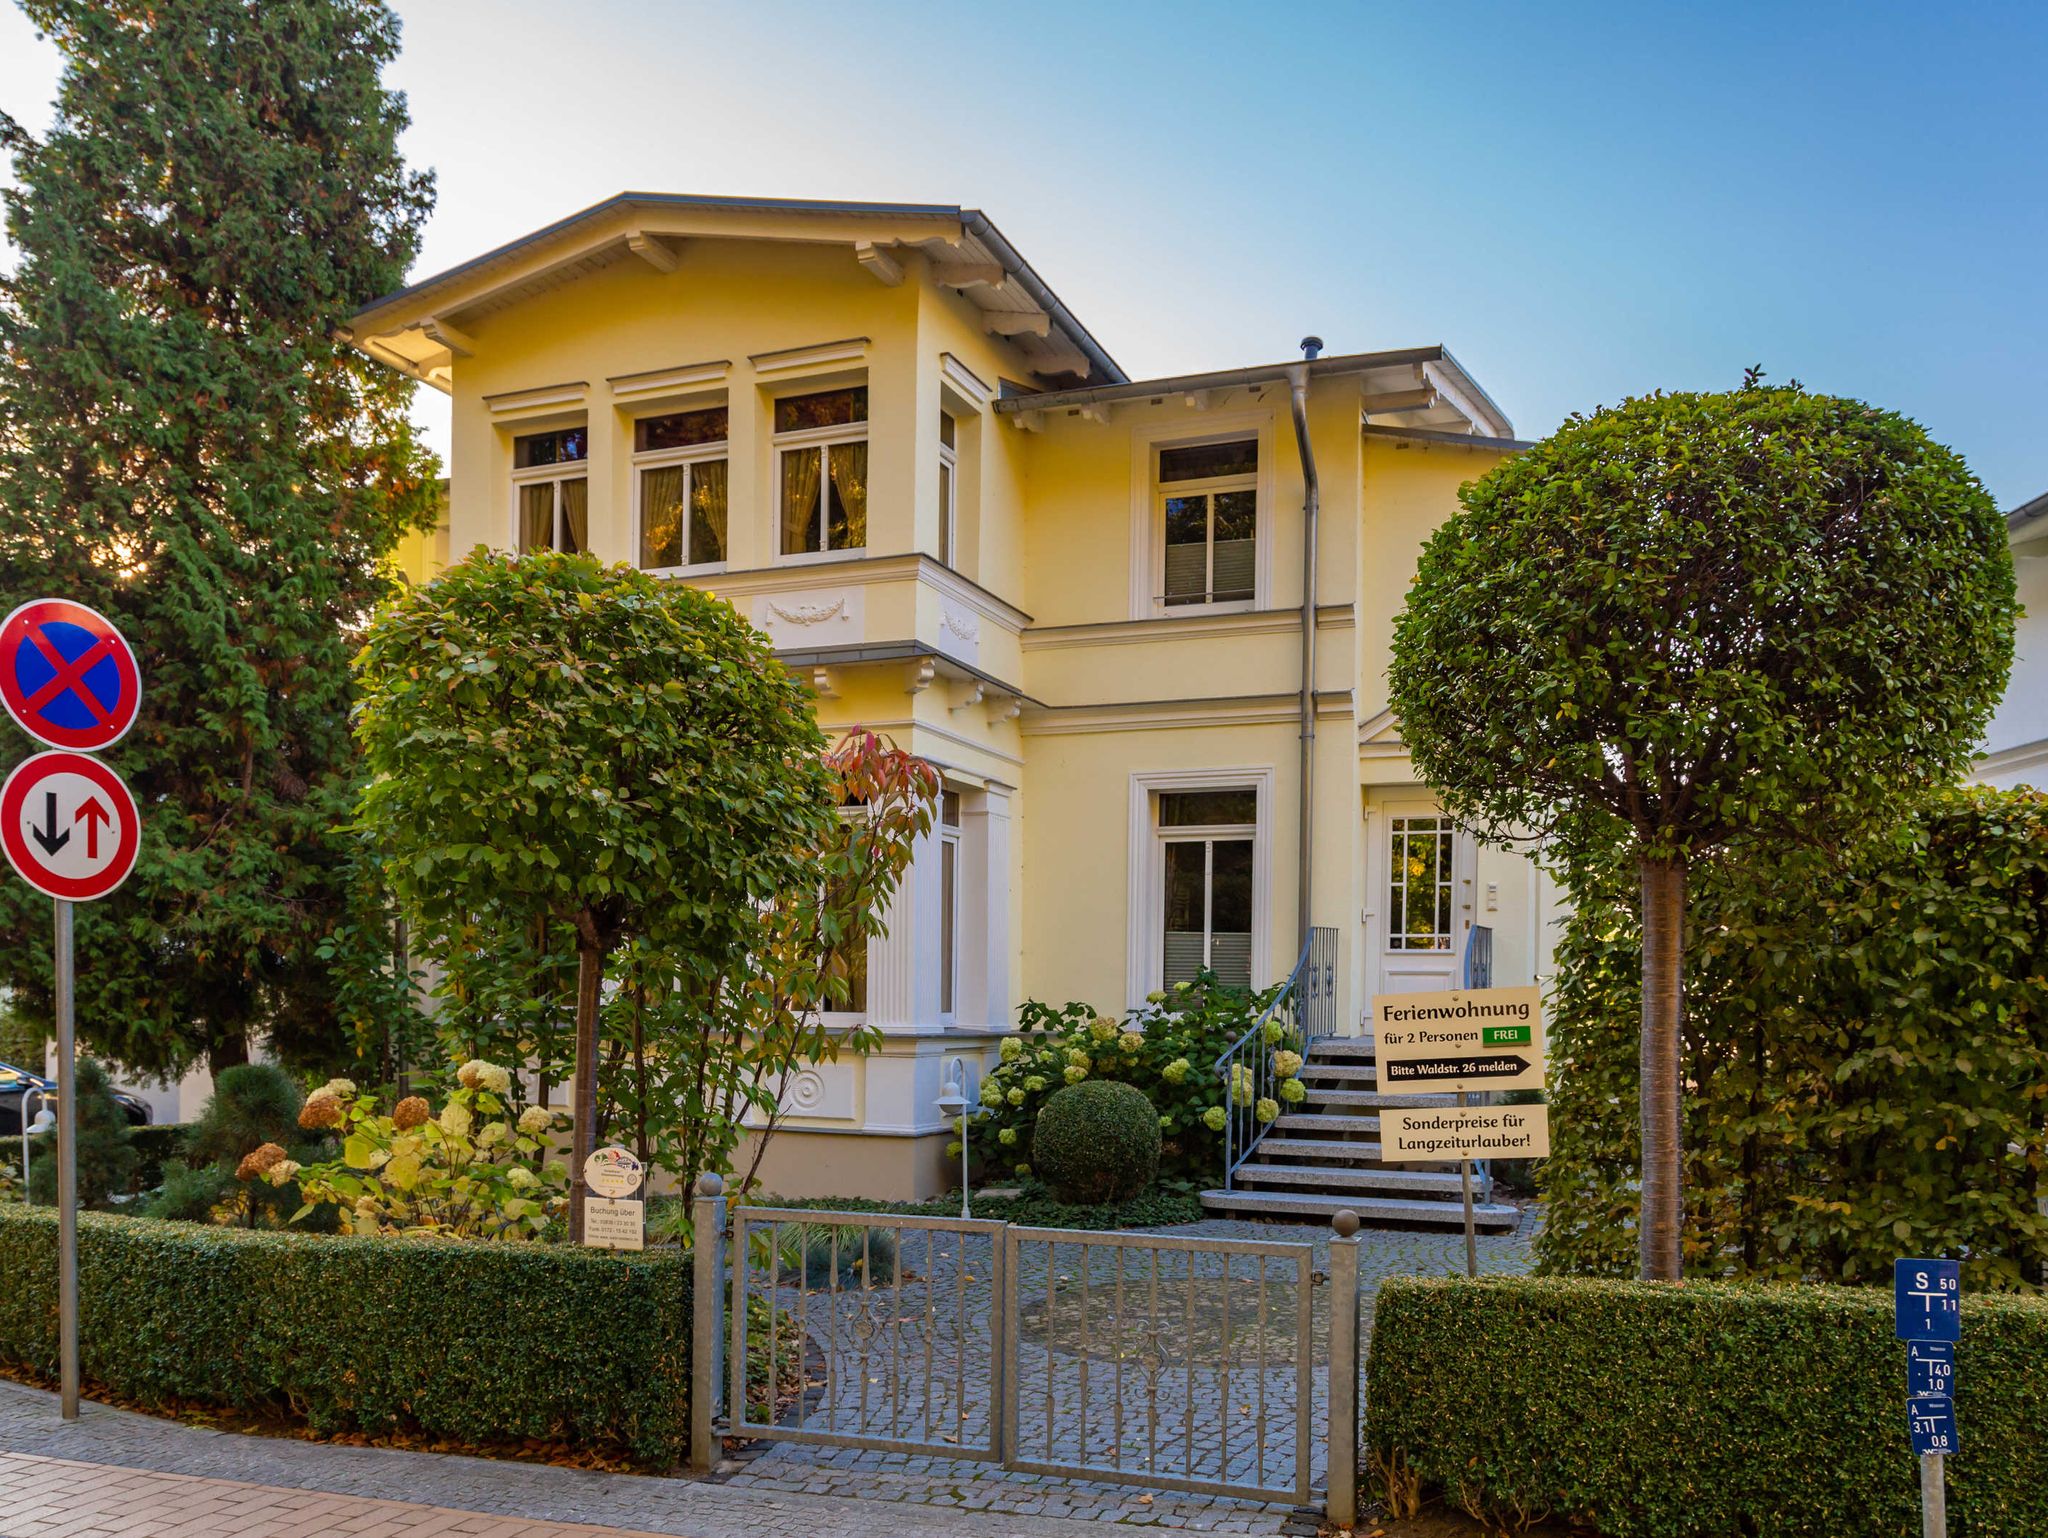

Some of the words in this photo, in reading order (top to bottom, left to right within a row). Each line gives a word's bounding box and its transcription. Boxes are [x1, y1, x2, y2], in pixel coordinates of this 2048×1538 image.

[1383, 1001, 1530, 1022] Ferienwohnung
[1384, 1033, 1404, 1045] für
[1407, 1033, 1416, 1044] 2
[1419, 1031, 1479, 1043] Personen
[1493, 1030, 1518, 1040] FREI
[1391, 1065, 1415, 1076] Bitte
[1416, 1063, 1460, 1075] Waldstr.
[1462, 1063, 1476, 1073] 26
[1478, 1061, 1518, 1072] melden
[1402, 1116, 1498, 1132] Sonderpreise
[1502, 1114, 1525, 1128] für
[1398, 1134, 1531, 1153] Langzeiturlauber!
[590, 1206, 619, 1217] Buchung
[619, 1207, 635, 1217] über
[1915, 1272, 1929, 1290] S
[1939, 1278, 1957, 1291] 50
[1940, 1299, 1957, 1312] 11
[1925, 1318, 1931, 1331] 1
[1911, 1345, 1919, 1357] A
[1934, 1364, 1951, 1377] 4.0
[1928, 1378, 1945, 1391] 1.0
[1911, 1403, 1919, 1416] A
[1912, 1421, 1930, 1435] 3.1
[1930, 1435, 1949, 1448] 0.8
